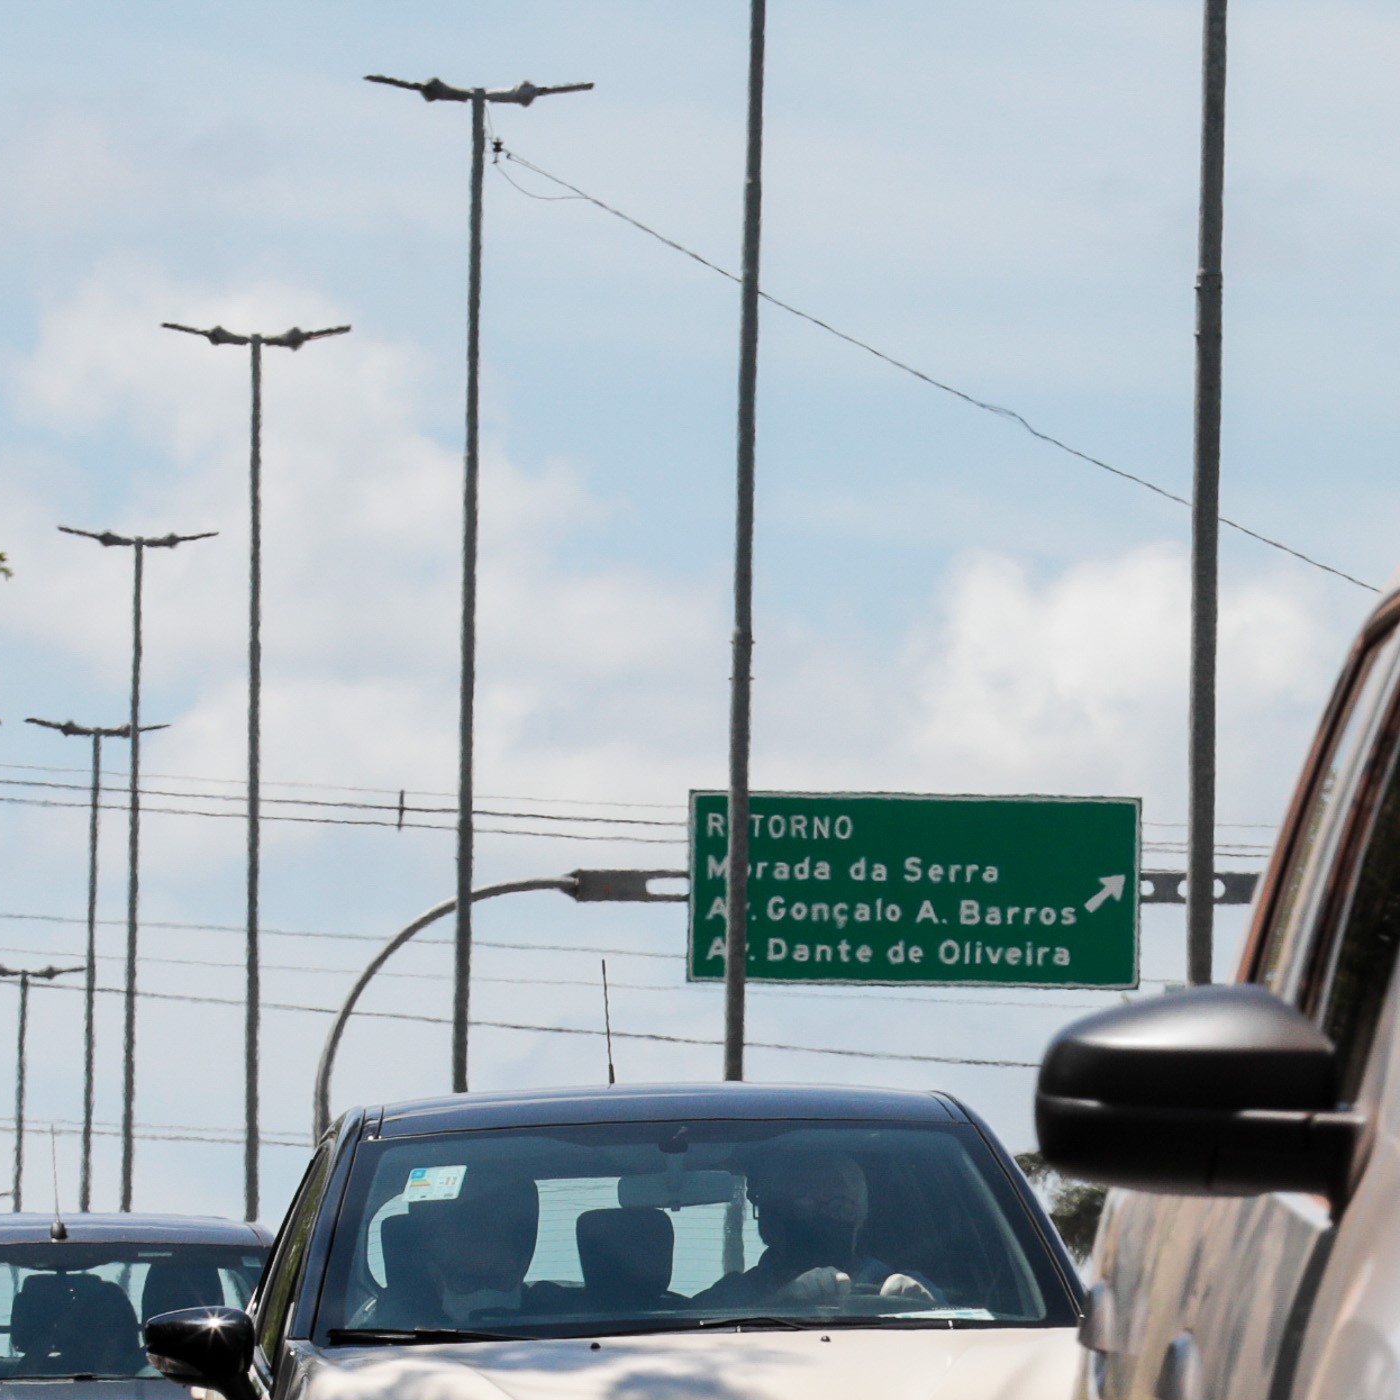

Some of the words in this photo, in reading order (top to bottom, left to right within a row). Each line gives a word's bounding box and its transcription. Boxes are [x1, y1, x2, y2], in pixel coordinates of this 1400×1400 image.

[706, 811, 854, 840] RTORNO
[706, 854, 832, 881] Mrada
[849, 855, 889, 882] da
[903, 856, 1000, 883] Serra
[705, 896, 758, 922] A.
[766, 895, 903, 930] Gonçalo
[915, 899, 948, 926] A.
[959, 899, 1078, 926] Barros
[705, 936, 757, 962] A.
[766, 937, 874, 963] Dante
[887, 939, 925, 965] de
[938, 939, 1071, 967] Oliveira
